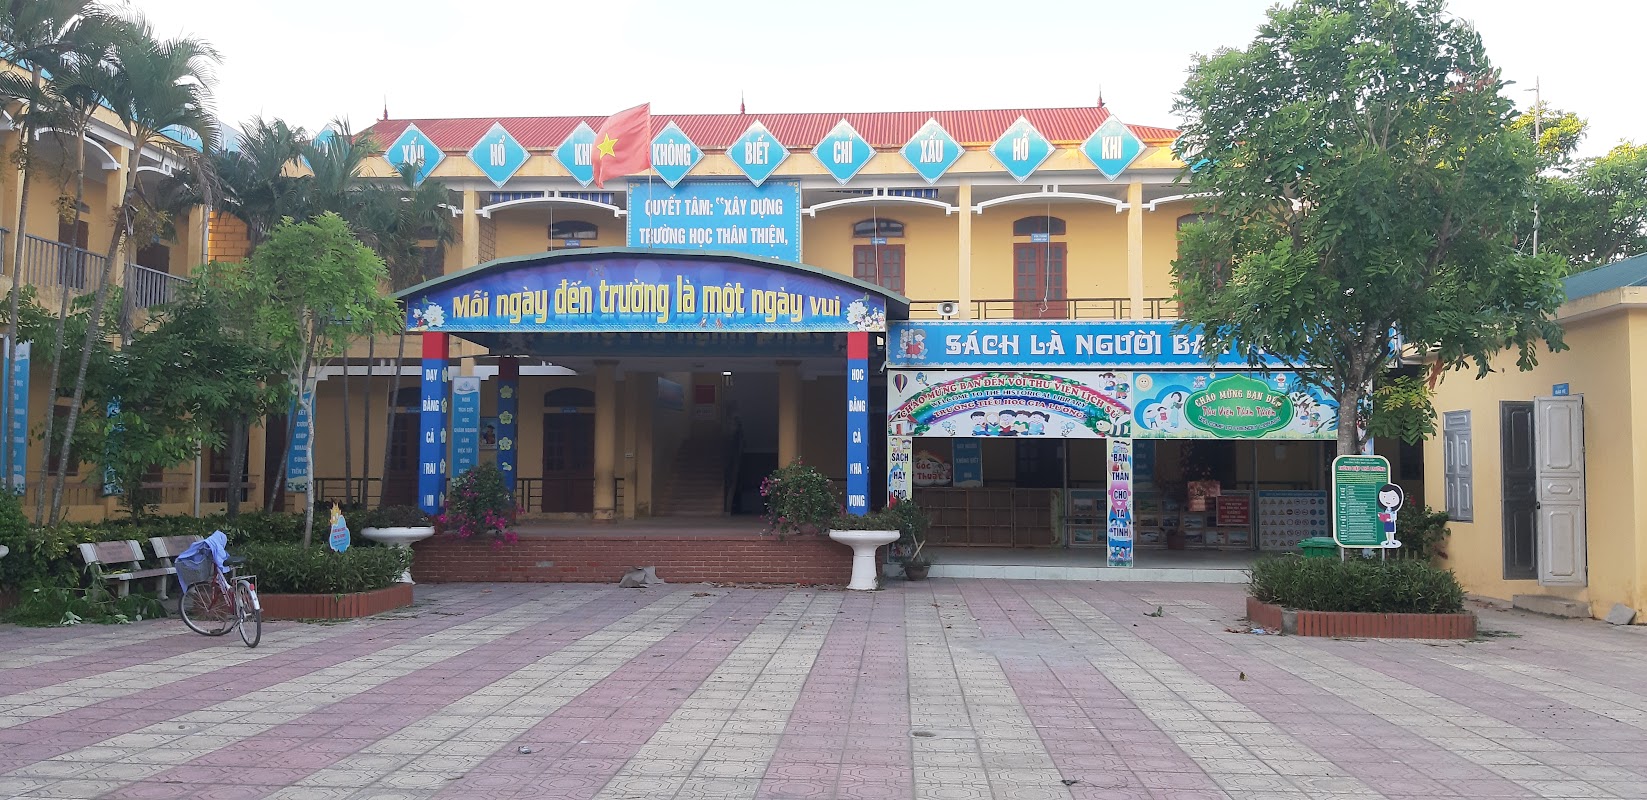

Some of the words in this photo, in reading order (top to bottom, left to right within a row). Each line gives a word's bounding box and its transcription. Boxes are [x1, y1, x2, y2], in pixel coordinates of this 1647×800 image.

[490, 134, 506, 167] HỔ
[652, 138, 692, 167] KHÔNG
[745, 134, 770, 165] BIẾT
[833, 133, 854, 164] CHỈ
[920, 131, 945, 163] XẤU
[1012, 129, 1030, 161] HỔ
[1101, 136, 1122, 160] KHI
[645, 194, 682, 216] QUYẾT
[685, 196, 714, 215] TÂM:
[750, 197, 783, 218] DỰNG
[639, 224, 686, 244] TRƯỜNG
[689, 228, 713, 247] HỌC
[716, 225, 747, 244] THÂN
[751, 225, 788, 247] THIỆN,
[453, 290, 489, 318] Mỗi
[496, 286, 548, 324] ngày
[554, 279, 594, 314] đến
[600, 278, 669, 324] trường
[677, 275, 695, 314] là
[703, 283, 746, 318] một
[752, 287, 803, 323] ngày
[810, 296, 841, 317] vui
[945, 329, 1020, 355] SÁCH
[1030, 329, 1066, 355] LÀ
[1075, 329, 1163, 355] NGƯỜI
[425, 369, 438, 382] DẠY
[851, 368, 864, 382] HỌC
[422, 395, 439, 412] BẰNG
[848, 395, 866, 412] BẰNG
[899, 394, 925, 418] CHÀO
[926, 383, 958, 401] MỪNG
[959, 379, 982, 392] BẠN
[983, 374, 1005, 387] ĐẾN
[1008, 377, 1027, 387] VỚI
[1029, 379, 1051, 389] THƯ
[1054, 380, 1080, 396] VIỆN
[1081, 390, 1105, 408] LỊCH
[972, 390, 983, 398] TO
[985, 389, 1000, 397] THE
[1002, 389, 1050, 400] HISTORICAL
[1053, 393, 1087, 409] LIBRARY
[1028, 399, 1046, 409] GIA
[1195, 392, 1217, 408] CHÀO
[1219, 388, 1243, 400] MỪNG
[1246, 389, 1265, 401] BẠN
[426, 428, 435, 443] CẢ
[852, 428, 862, 443] CẢ
[893, 472, 907, 480] HAY
[1114, 491, 1128, 500] CHO
[1116, 509, 1125, 518] TA
